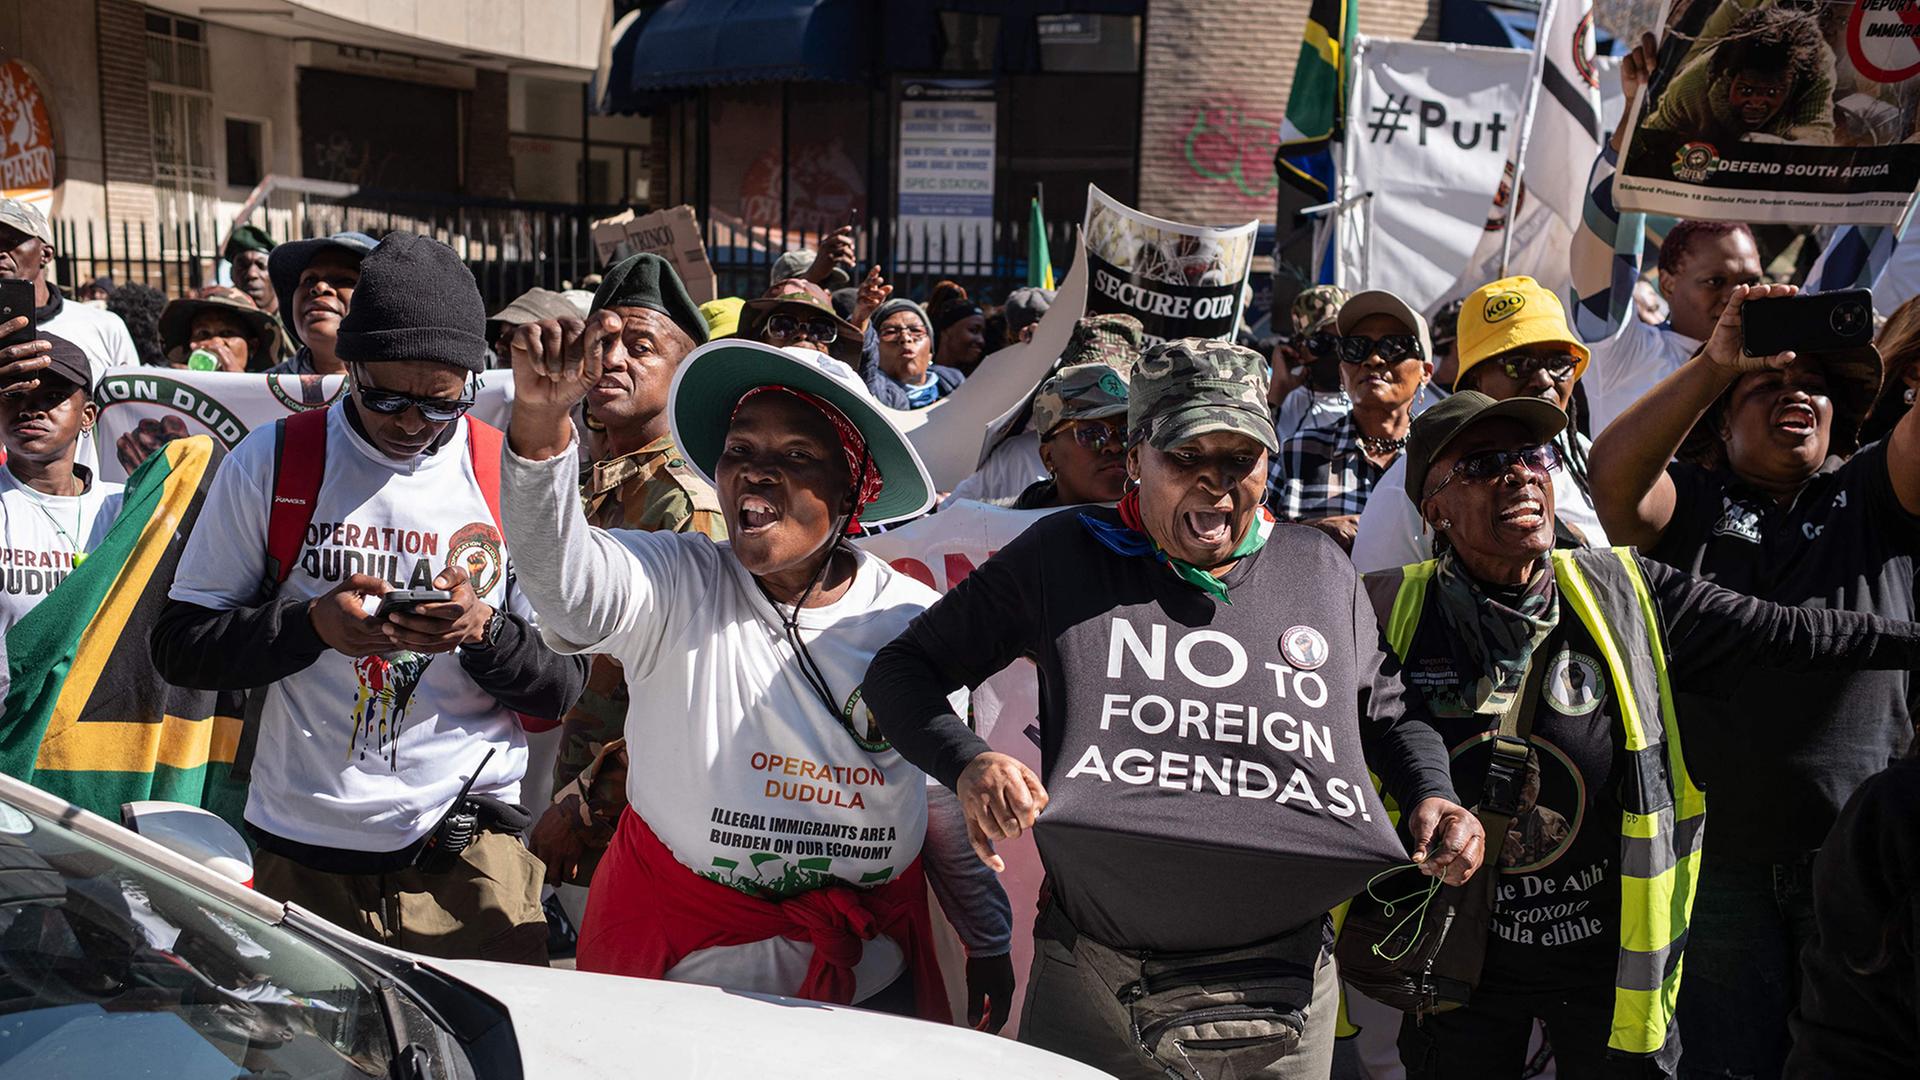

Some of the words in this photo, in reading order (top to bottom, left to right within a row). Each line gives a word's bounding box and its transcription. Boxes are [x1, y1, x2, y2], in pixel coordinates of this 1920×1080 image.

[1368, 94, 1506, 152] #Put
[904, 177, 936, 190] SPEC
[938, 178, 990, 191] STATION
[1718, 159, 1781, 175] DEFEND
[1785, 163, 1839, 177] SOUTH
[1841, 163, 1889, 178] AFRICA
[1619, 182, 1655, 193] Standard
[1656, 187, 1689, 198] Printers
[1094, 269, 1191, 319] SECURE
[1193, 294, 1234, 320] OUR
[1487, 297, 1520, 317] KOO
[305, 522, 438, 556] OPERATION
[0, 546, 76, 568] PERATI
[301, 548, 433, 591] DUDULA
[0, 567, 68, 596] UDU
[1106, 617, 1248, 689] NO
[1265, 662, 1329, 708] TO
[1100, 693, 1336, 763] FOREIGN
[751, 752, 885, 786] OPERATION
[1065, 744, 1372, 822] AGENDAS!
[765, 779, 865, 810] DUDULA
[711, 807, 766, 831] ILLEGAL
[769, 816, 857, 841] IMMIGRANTS
[859, 827, 886, 841] ARE
[887, 826, 896, 841] A
[709, 828, 771, 851] BURDEN
[774, 838, 793, 854] ON
[796, 840, 824, 856] OUR
[827, 842, 892, 860] ECONOMY
[1521, 875, 1556, 898] De
[1541, 916, 1603, 946] elihle
